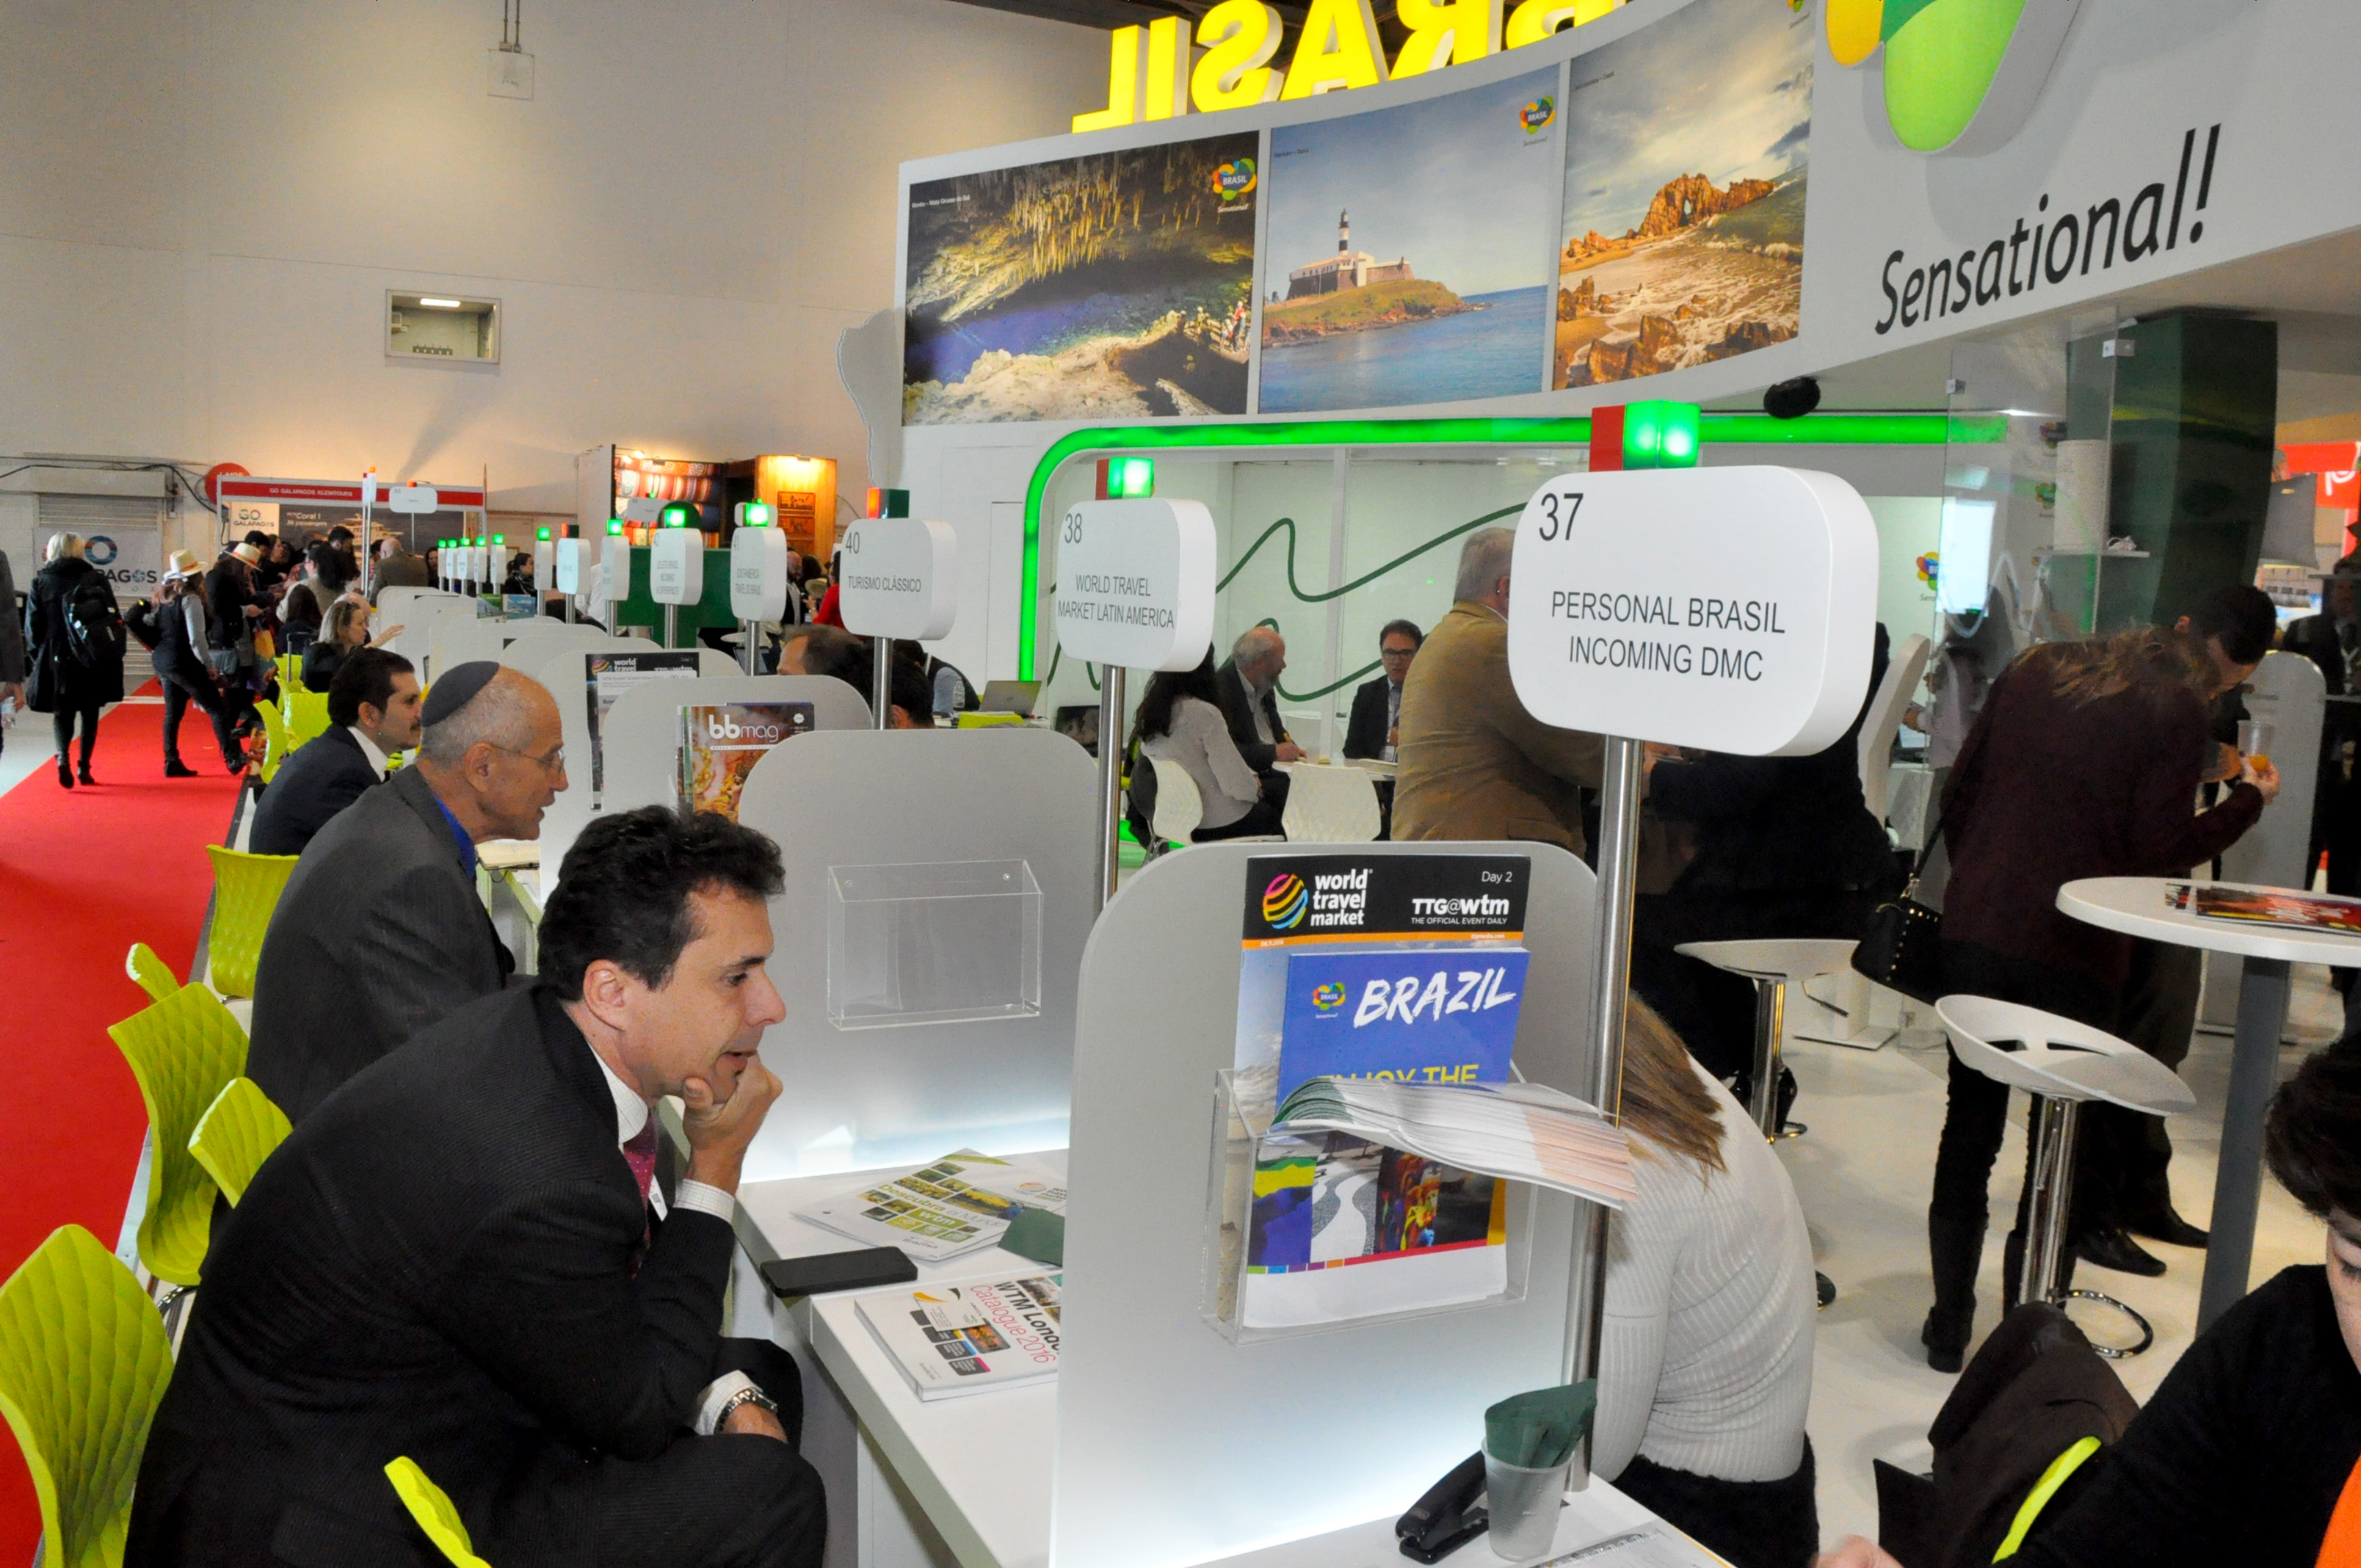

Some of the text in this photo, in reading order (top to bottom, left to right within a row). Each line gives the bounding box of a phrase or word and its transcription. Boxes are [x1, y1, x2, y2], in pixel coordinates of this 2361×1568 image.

[1222, 175, 1247, 186] BRASIL
[1874, 123, 2222, 335] Sensational!
[239, 509, 261, 520] GO
[296, 512, 316, 520] Coral
[1539, 492, 1584, 542] 37
[1065, 512, 1082, 543] 38
[845, 531, 860, 554] 40
[848, 575, 922, 592] TURISMO CLÁSSICO
[1076, 574, 1151, 596] WORLD TRAVEL
[1058, 600, 1175, 629] MARKET LATIN AMERICA
[1552, 590, 1785, 634] PERSONAL BRASIL
[614, 658, 637, 666] world
[1570, 636, 1763, 681] INCOMING DMC
[708, 714, 779, 742] bbmag
[1315, 868, 1368, 890] world
[1481, 871, 1513, 884] Day 2
[1313, 890, 1367, 910] travel
[1412, 893, 1510, 915] TTG@wtm
[1310, 908, 1365, 926] market
[1411, 917, 1508, 925] THE OFFICIAL EVENT DAILY
[1319, 992, 1338, 1001] BRASIL
[1352, 967, 1517, 1028] BRAZIL
[879, 1183, 946, 1212] Descubra
[994, 1281, 1036, 1310] WTM
[970, 1285, 1057, 1363] Catalogue 2016
